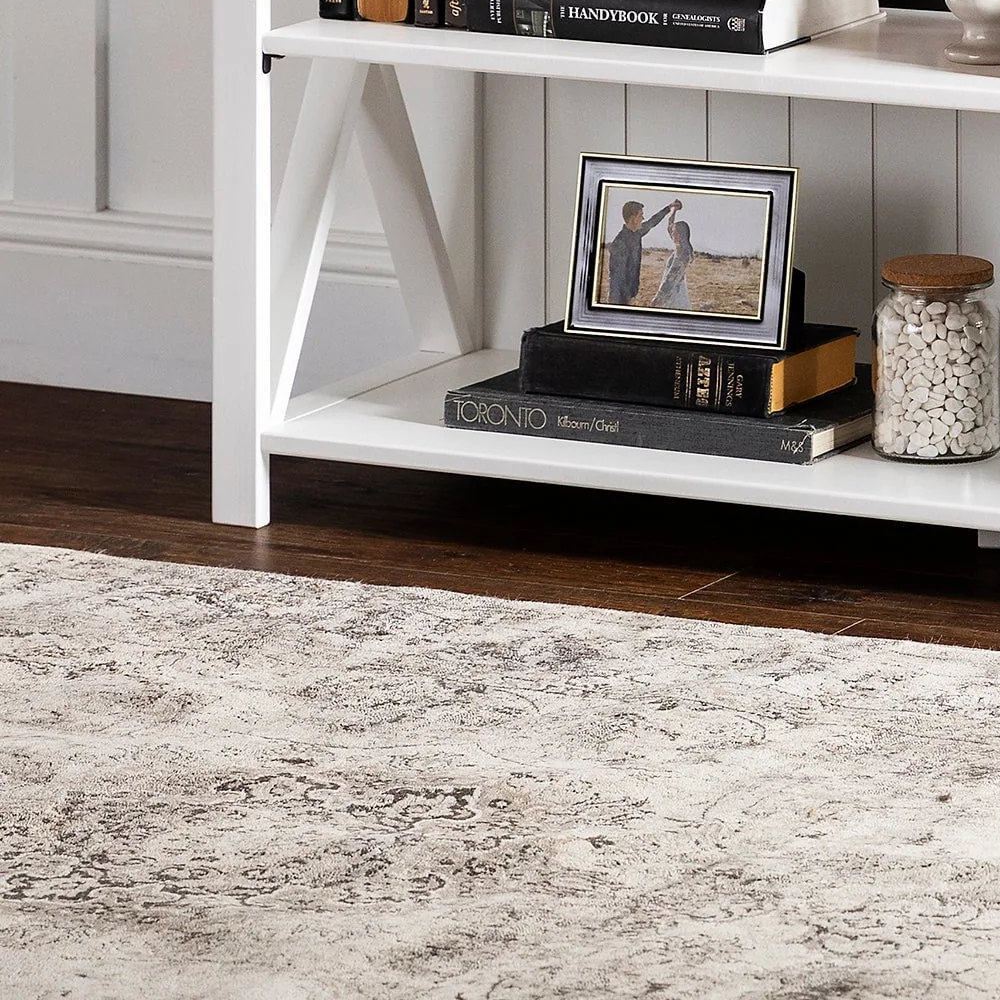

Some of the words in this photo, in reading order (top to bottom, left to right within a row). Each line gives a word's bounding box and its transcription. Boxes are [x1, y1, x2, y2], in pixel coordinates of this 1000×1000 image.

[568, 6, 660, 25] HANDYBOOK
[672, 13, 721, 23] GENEALOGISTS
[695, 355, 712, 408] AZTEC
[725, 362, 736, 408] JENNINGS
[734, 374, 744, 399] GARY
[454, 400, 547, 430] TORONTO
